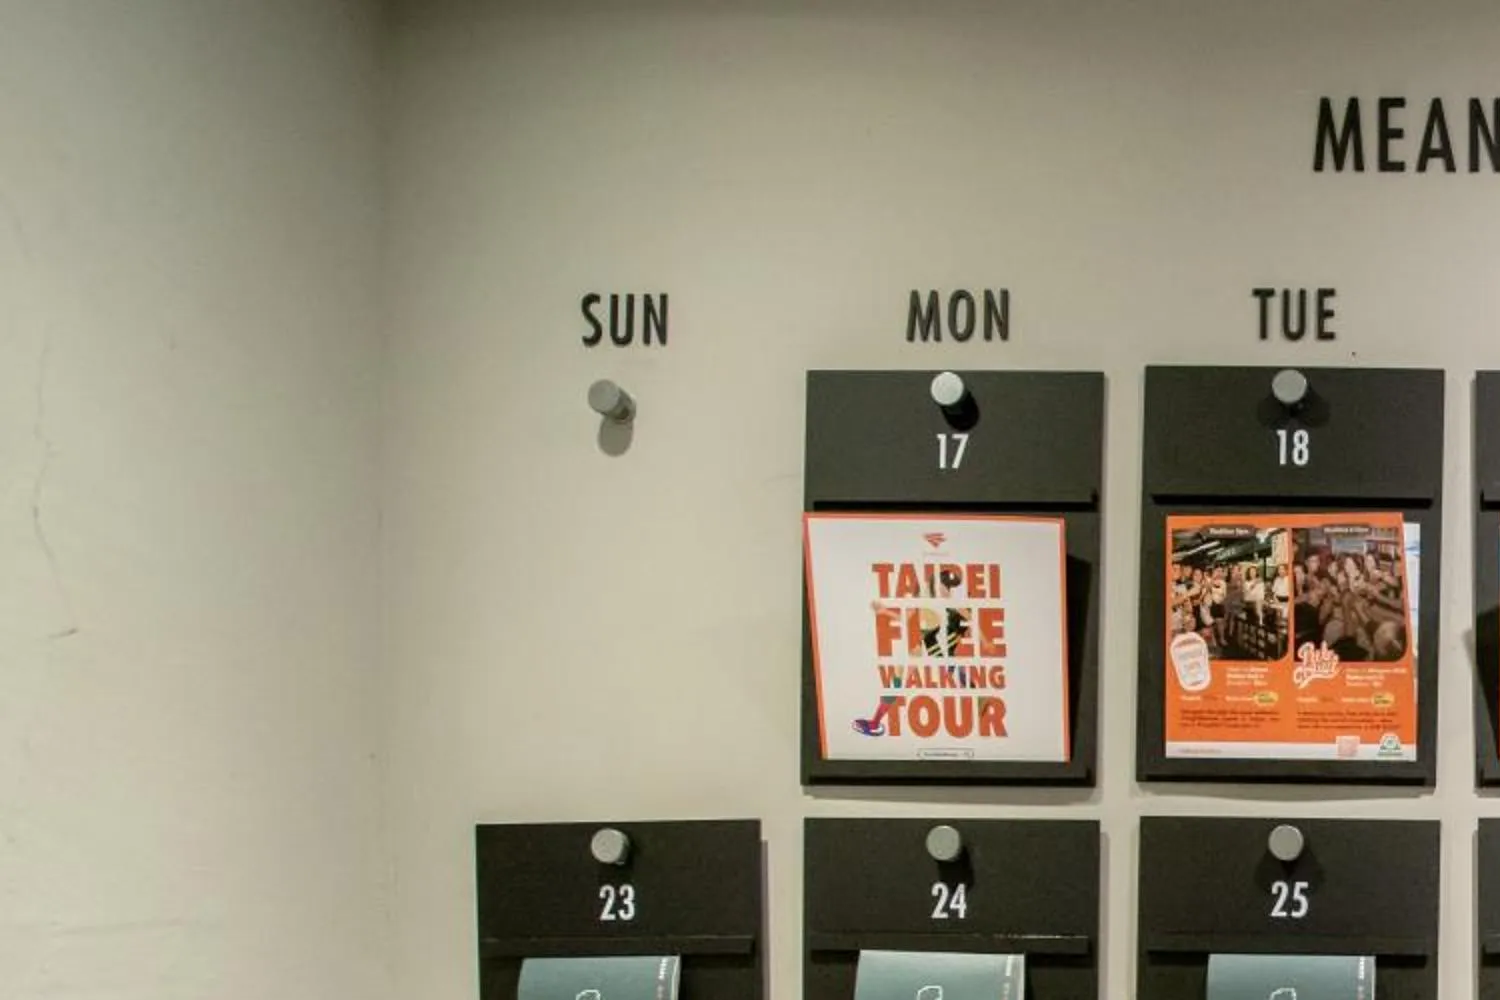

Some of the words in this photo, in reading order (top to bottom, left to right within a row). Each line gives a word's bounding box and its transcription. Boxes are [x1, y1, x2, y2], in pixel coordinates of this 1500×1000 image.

[581, 292, 669, 348] SUN
[906, 288, 1010, 343] MON
[1251, 287, 1337, 342] TUE
[936, 433, 969, 469] 17
[1276, 429, 1309, 466] 18
[872, 563, 1001, 599] TAIPEI
[874, 607, 1007, 657] FREE
[878, 665, 1006, 690] WALKING
[880, 695, 1008, 738] TOUR
[599, 884, 635, 921] 23
[931, 882, 967, 919] 24
[1270, 880, 1309, 918] 25
